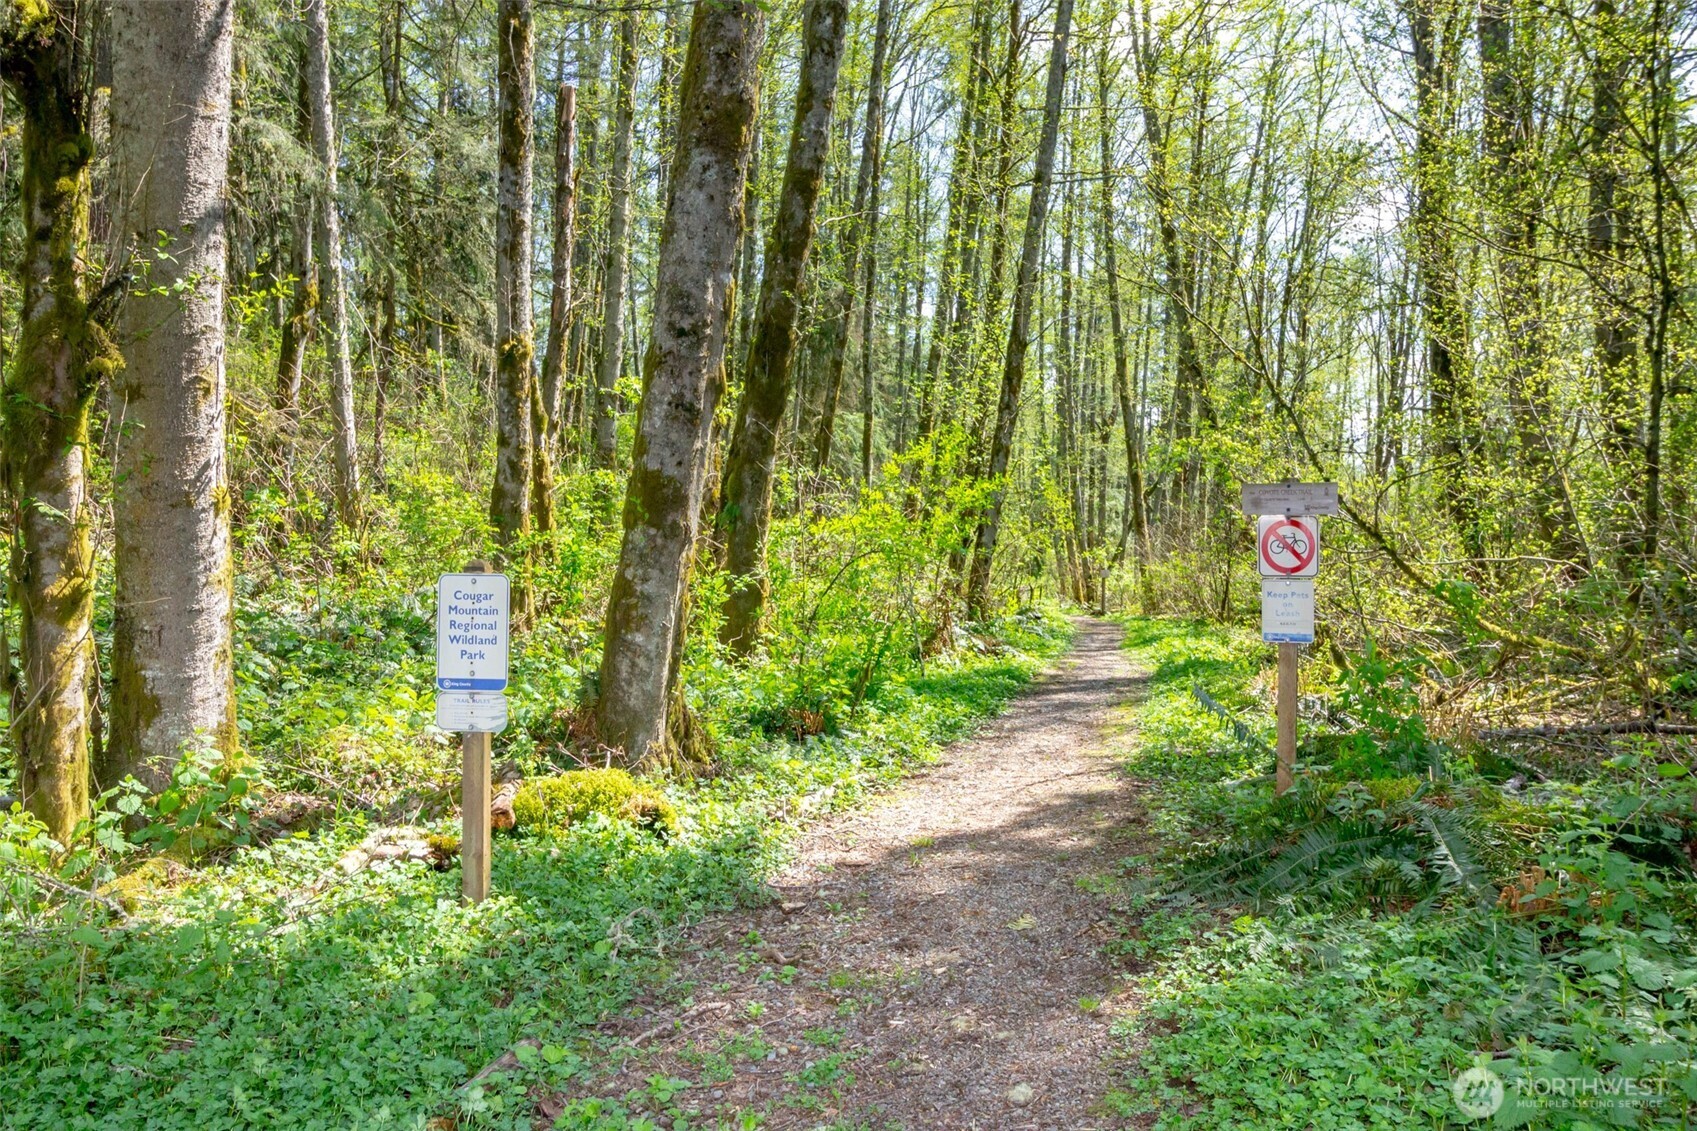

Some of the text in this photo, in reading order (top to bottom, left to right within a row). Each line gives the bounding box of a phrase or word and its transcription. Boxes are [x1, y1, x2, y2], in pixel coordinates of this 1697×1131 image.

[453, 590, 494, 603] Cougar
[1267, 591, 1288, 600] Keep
[448, 605, 499, 615] Mountain
[449, 619, 497, 632] Regional
[448, 635, 498, 645] Wildland
[460, 650, 485, 660] Park
